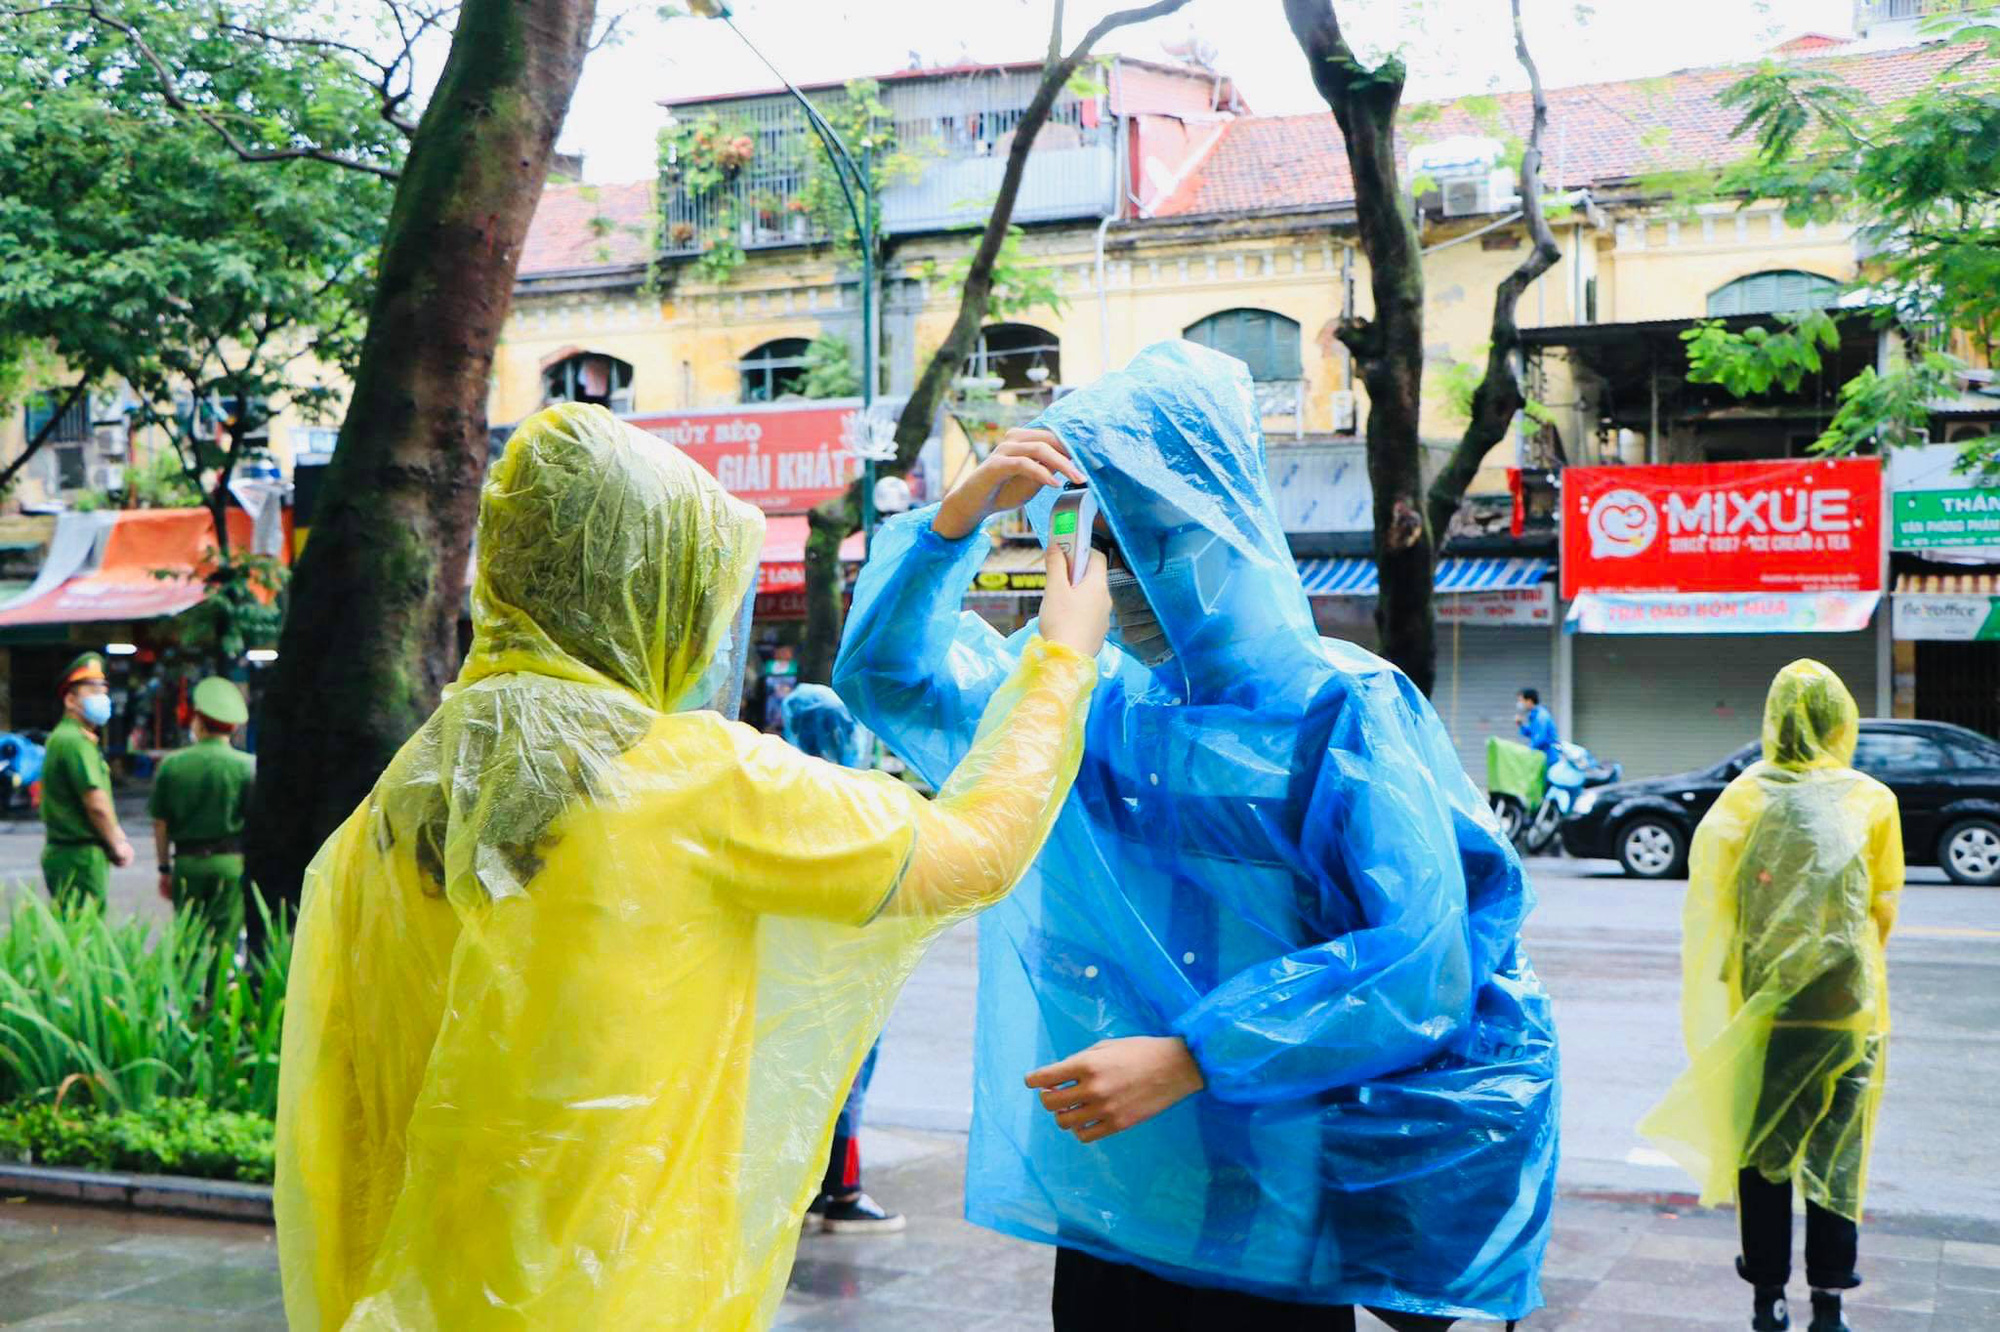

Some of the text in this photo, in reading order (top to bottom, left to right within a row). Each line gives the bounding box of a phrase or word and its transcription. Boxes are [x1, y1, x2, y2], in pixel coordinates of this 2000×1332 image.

[717, 442, 847, 492] GIẢI KHÁT
[1667, 489, 1851, 534] MIXUE
